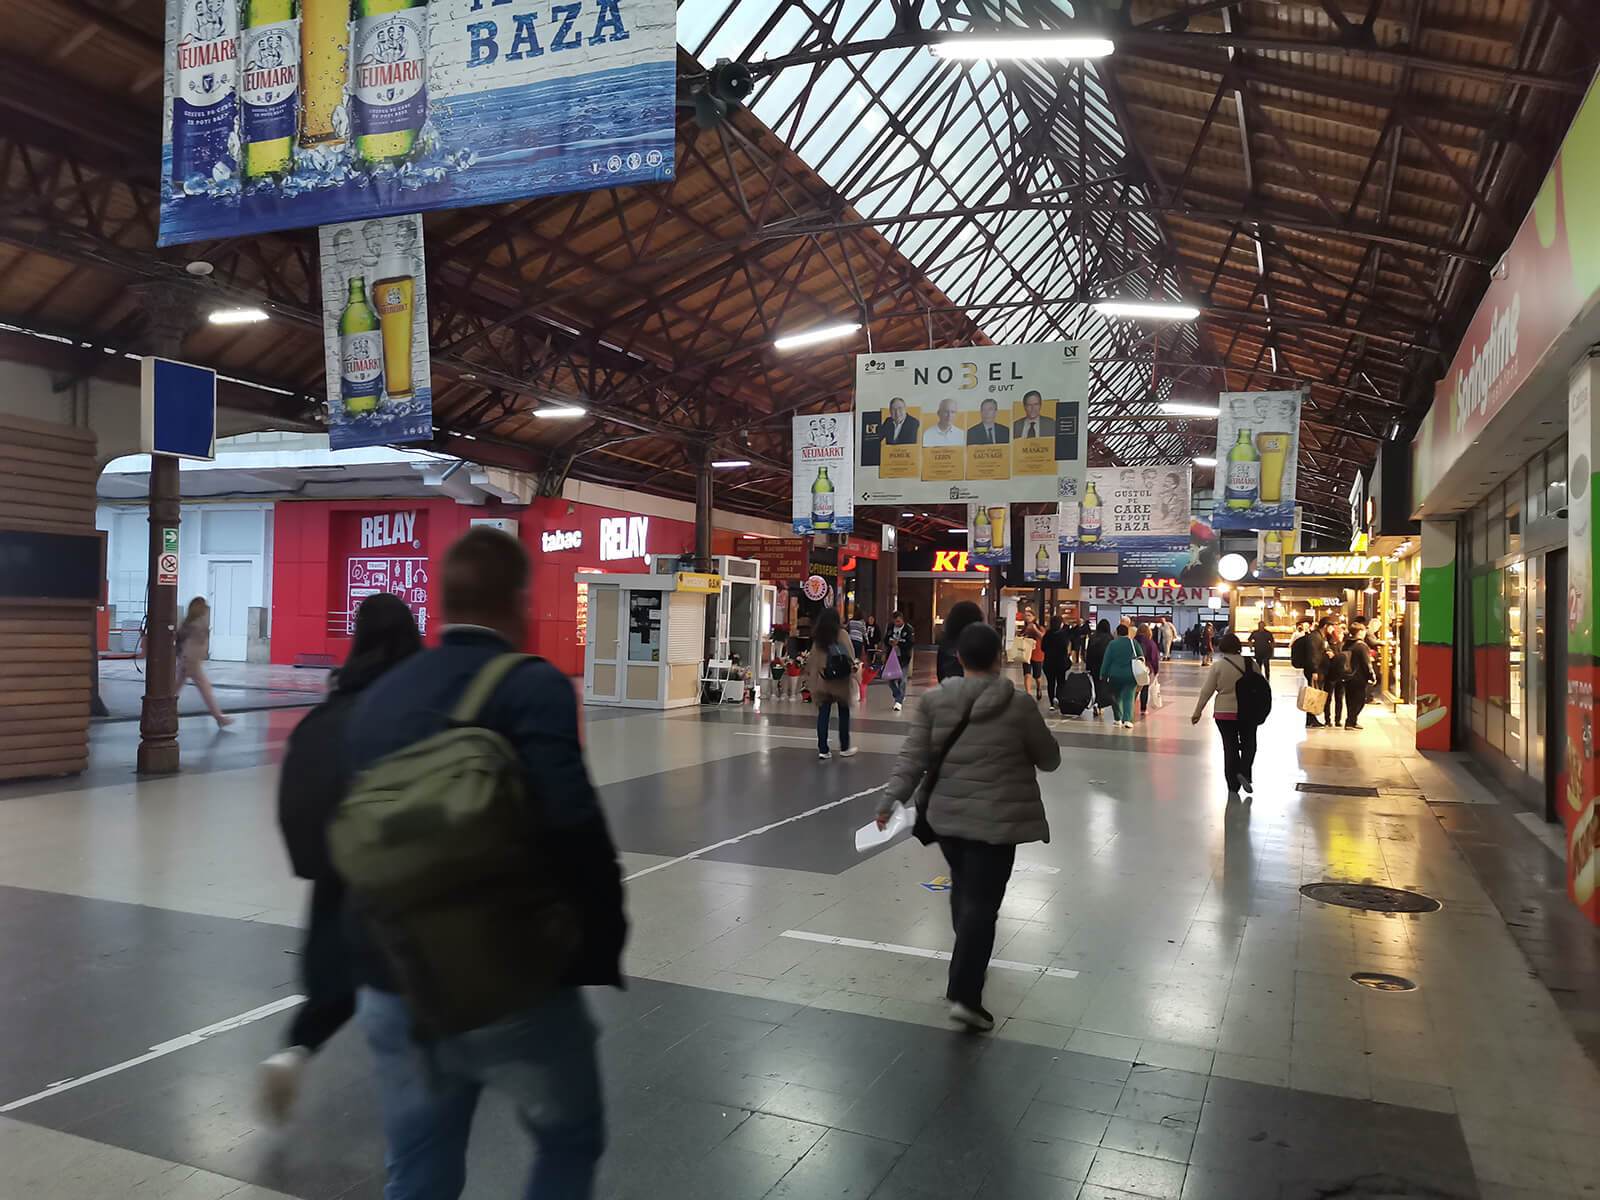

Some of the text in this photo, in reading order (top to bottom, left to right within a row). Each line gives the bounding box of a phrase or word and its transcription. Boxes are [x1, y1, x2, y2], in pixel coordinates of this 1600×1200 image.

[466, 0, 630, 68] BAZA
[801, 446, 845, 459] NEUMARKT
[1114, 490, 1151, 498] GUSTUL
[1114, 504, 1151, 514] CARE
[361, 511, 416, 549] RELAY
[1115, 522, 1151, 531] BAZA
[541, 529, 582, 552] tabac
[600, 516, 649, 561] RELAY
[1286, 556, 1381, 575] SUBWAY
